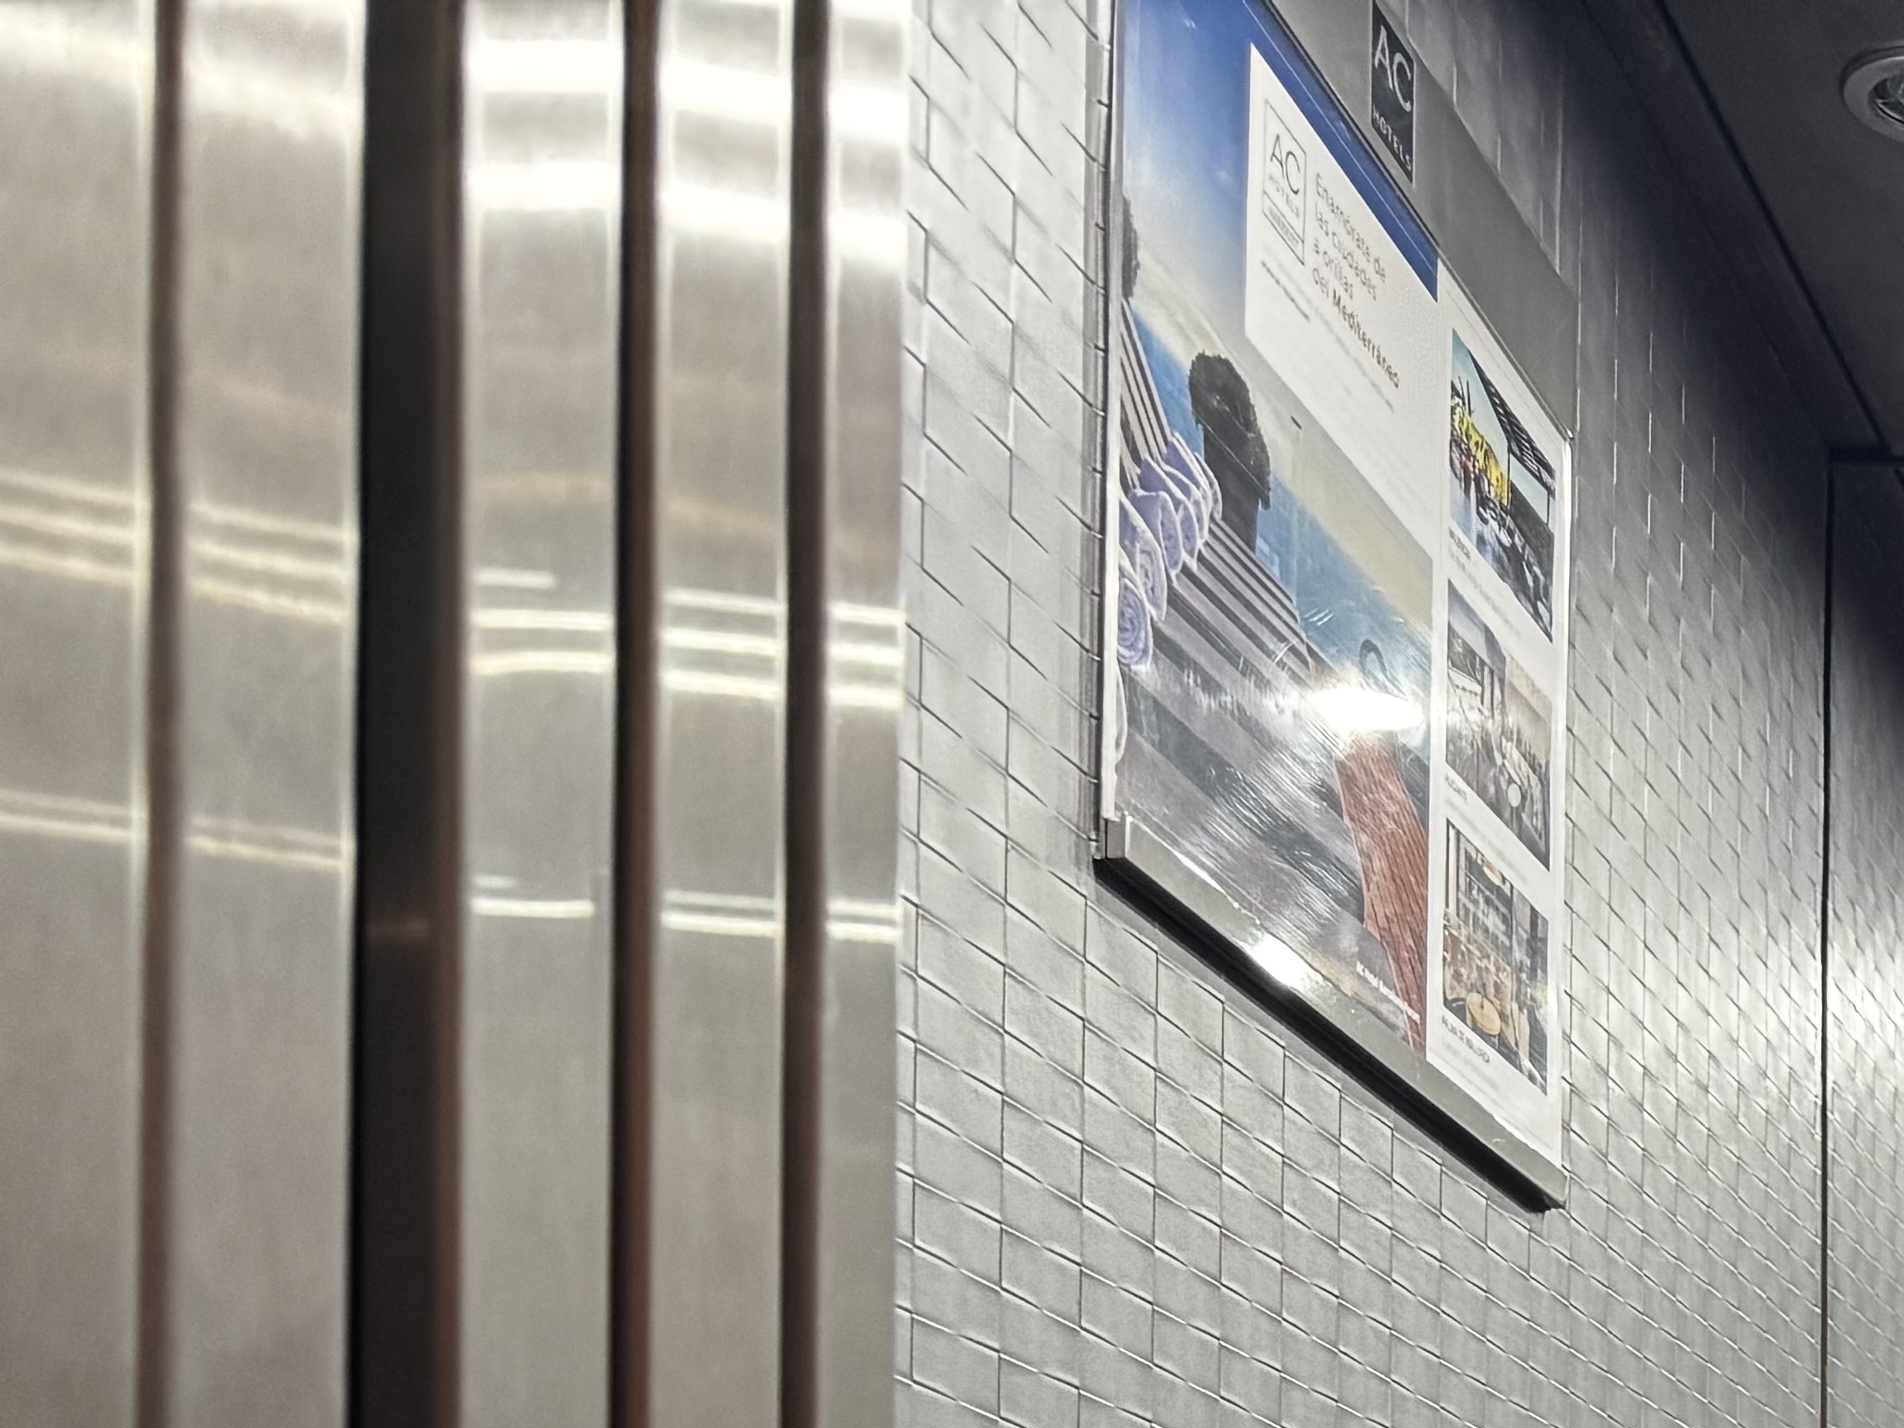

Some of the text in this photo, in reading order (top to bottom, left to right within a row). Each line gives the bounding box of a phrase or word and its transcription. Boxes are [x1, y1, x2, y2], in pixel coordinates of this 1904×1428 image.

[1374, 24, 1412, 112] AC
[1270, 133, 1301, 196] AC
[1372, 103, 1412, 172] HOTELS
